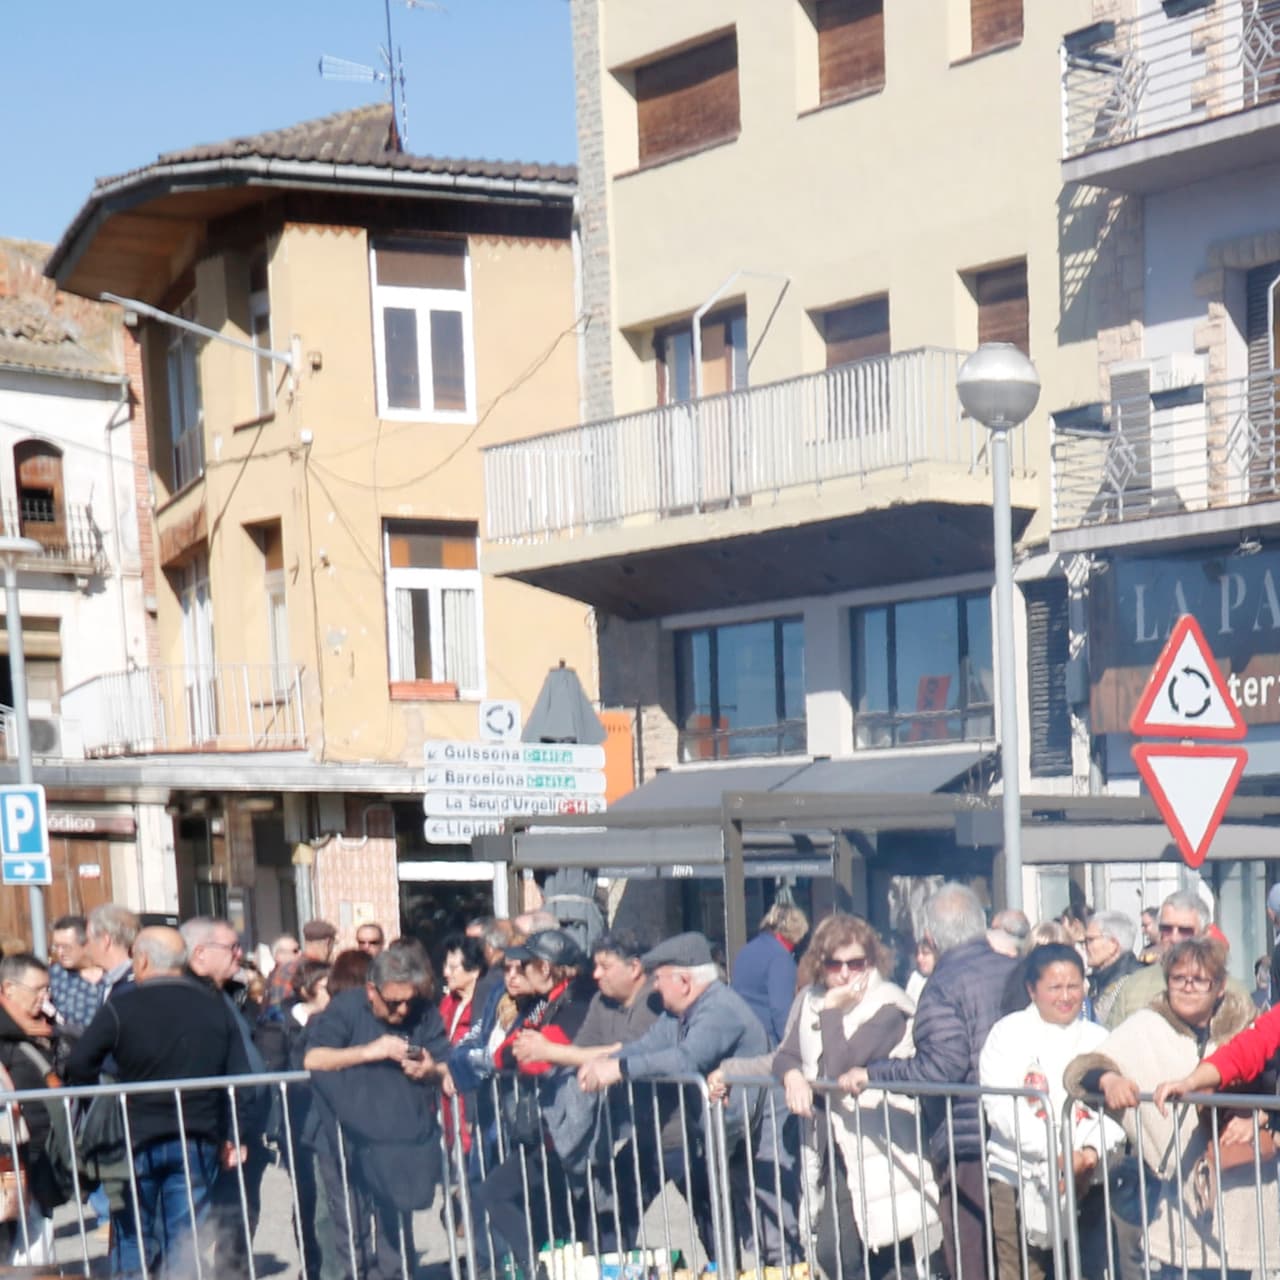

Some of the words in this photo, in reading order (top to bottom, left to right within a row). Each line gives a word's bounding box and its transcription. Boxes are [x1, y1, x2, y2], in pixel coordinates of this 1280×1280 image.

[1134, 577, 1190, 643] LA
[445, 746, 519, 761] Guissona
[445, 770, 524, 786] Barcelona
[446, 797, 462, 810] La
[469, 796, 496, 811] Seu
[500, 796, 555, 815] d'Urgell
[5, 794, 34, 852] P
[48, 813, 96, 833] ódico
